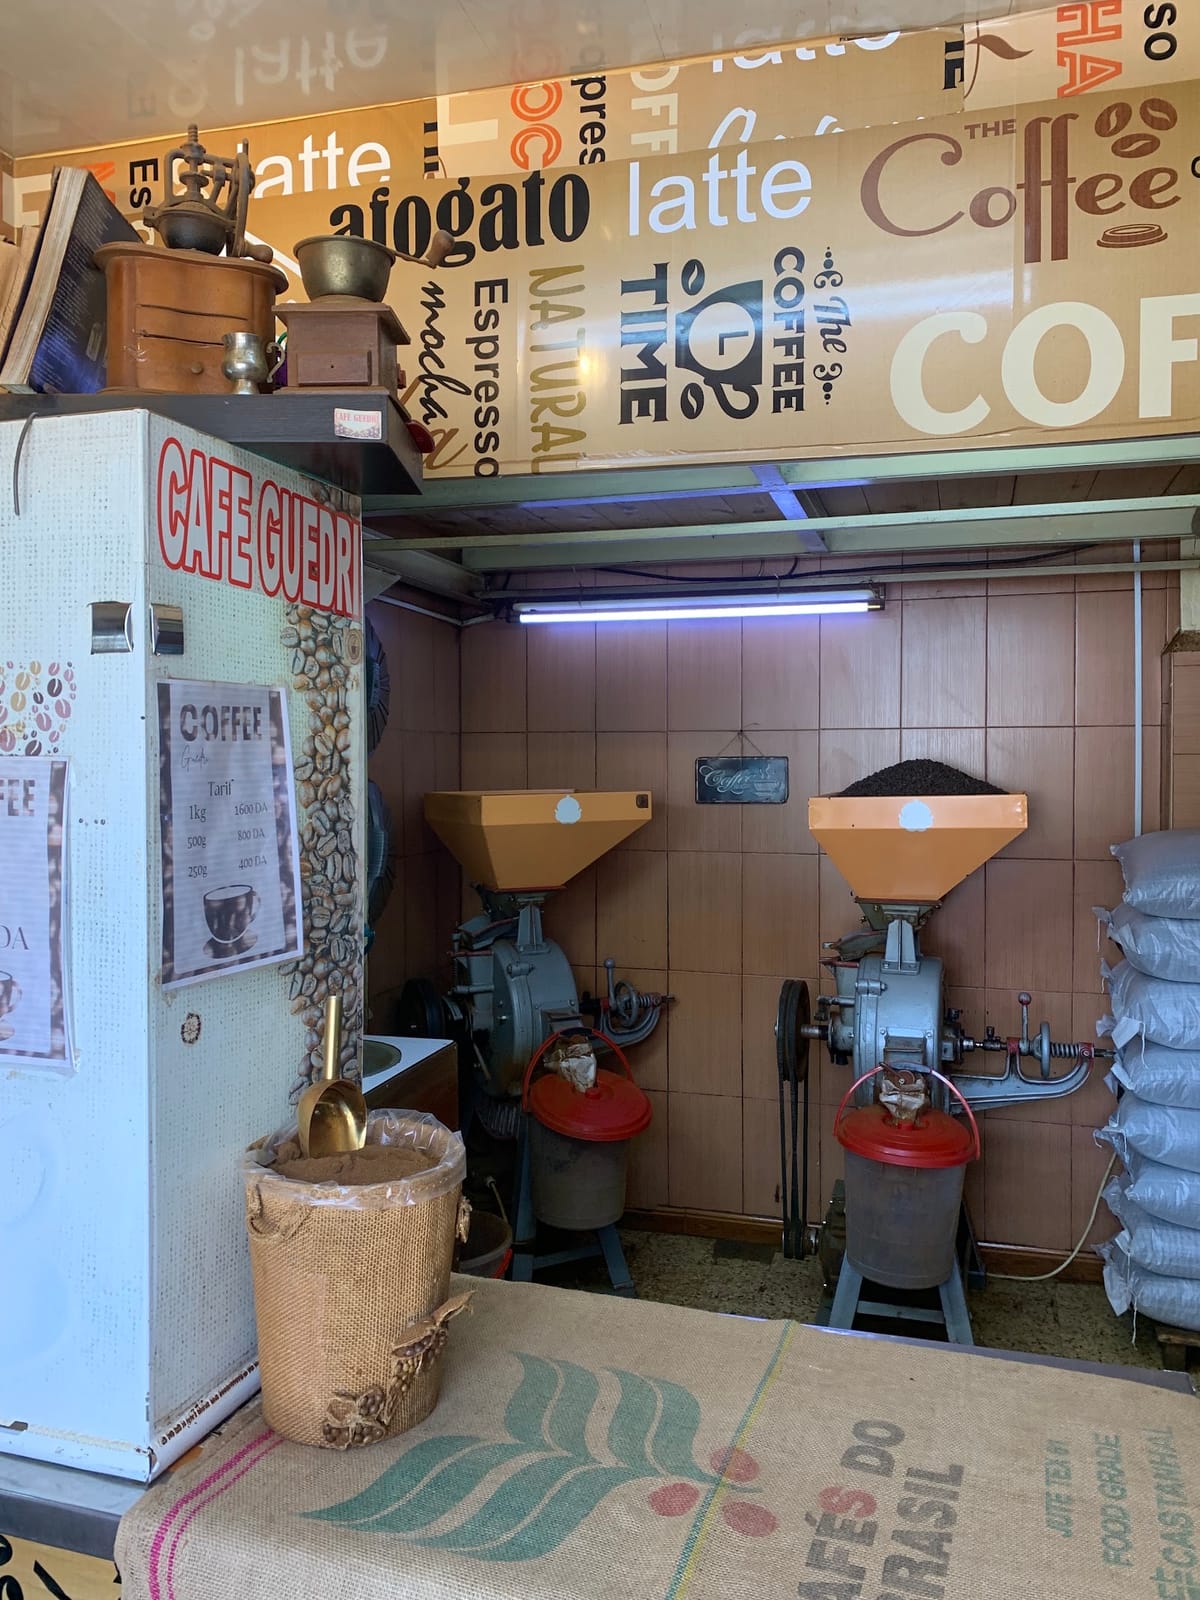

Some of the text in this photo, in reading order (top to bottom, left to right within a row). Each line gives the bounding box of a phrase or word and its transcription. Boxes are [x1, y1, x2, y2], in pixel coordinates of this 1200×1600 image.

[963, 119, 1017, 140] THE
[329, 169, 590, 269] afogato
[628, 153, 813, 236] latte
[860, 112, 1182, 264] Coffee
[529, 264, 587, 475] NATURAL
[618, 261, 670, 425] TIME
[771, 246, 806, 414] COFFEE
[813, 296, 852, 353] The
[465, 278, 509, 477] Espresso
[157, 436, 364, 620] CAFE GUEDRI
[180, 703, 262, 742] COFFEE
[187, 835, 207, 850] 500g
[189, 804, 207, 823] 1kg
[234, 802, 254, 816] 1600
[188, 865, 208, 878] 250g
[840, 1418, 905, 1479] DO
[874, 1463, 964, 1600] RASIL
[1093, 1432, 1134, 1568] FOOD GRADE
